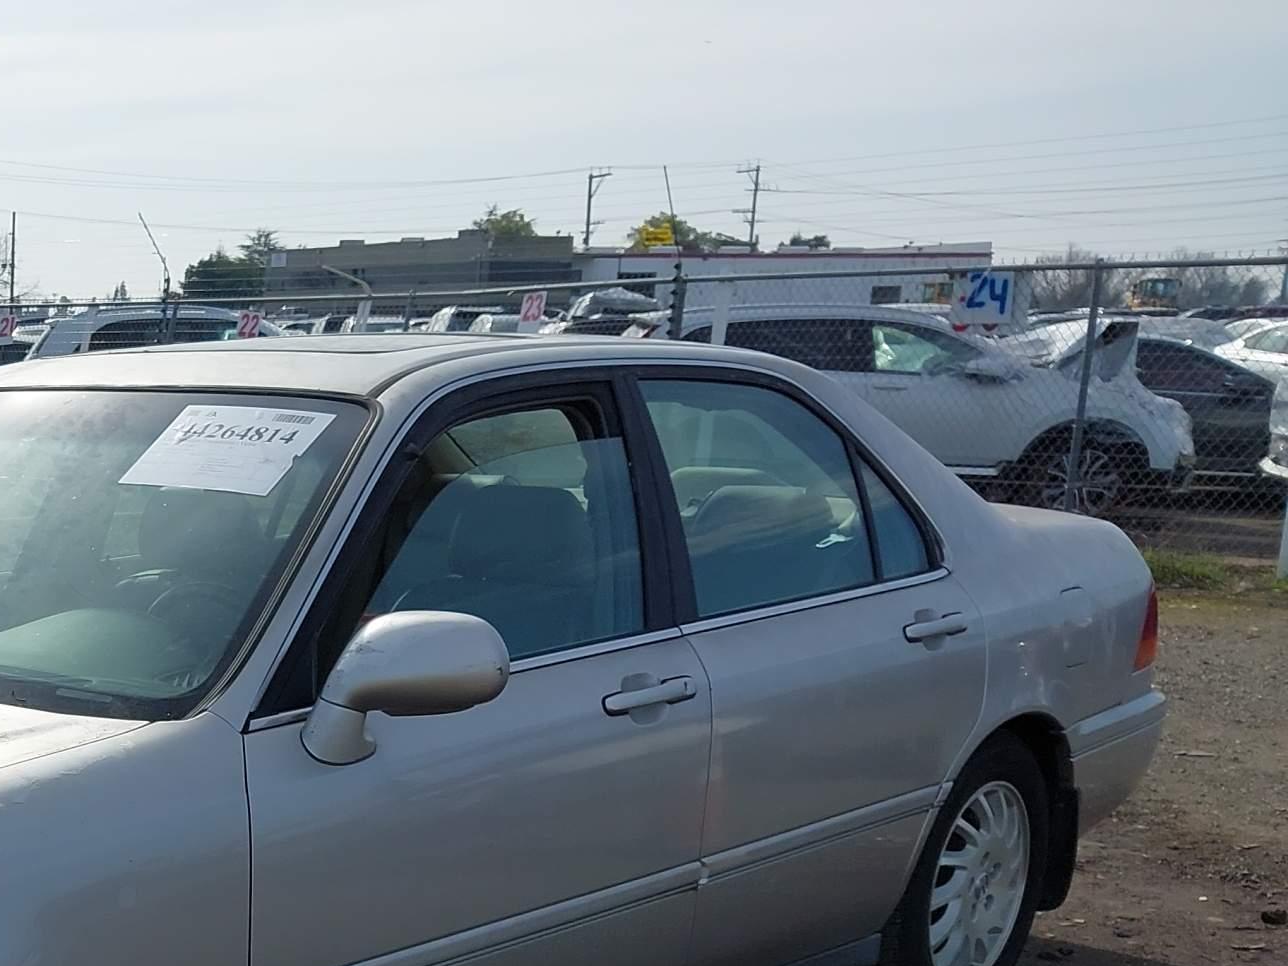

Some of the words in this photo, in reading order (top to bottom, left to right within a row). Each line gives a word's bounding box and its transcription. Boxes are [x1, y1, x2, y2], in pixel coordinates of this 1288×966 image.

[965, 271, 1009, 314] 24
[525, 294, 544, 322] 23
[238, 312, 261, 338] 22
[177, 422, 300, 446] 44264814
